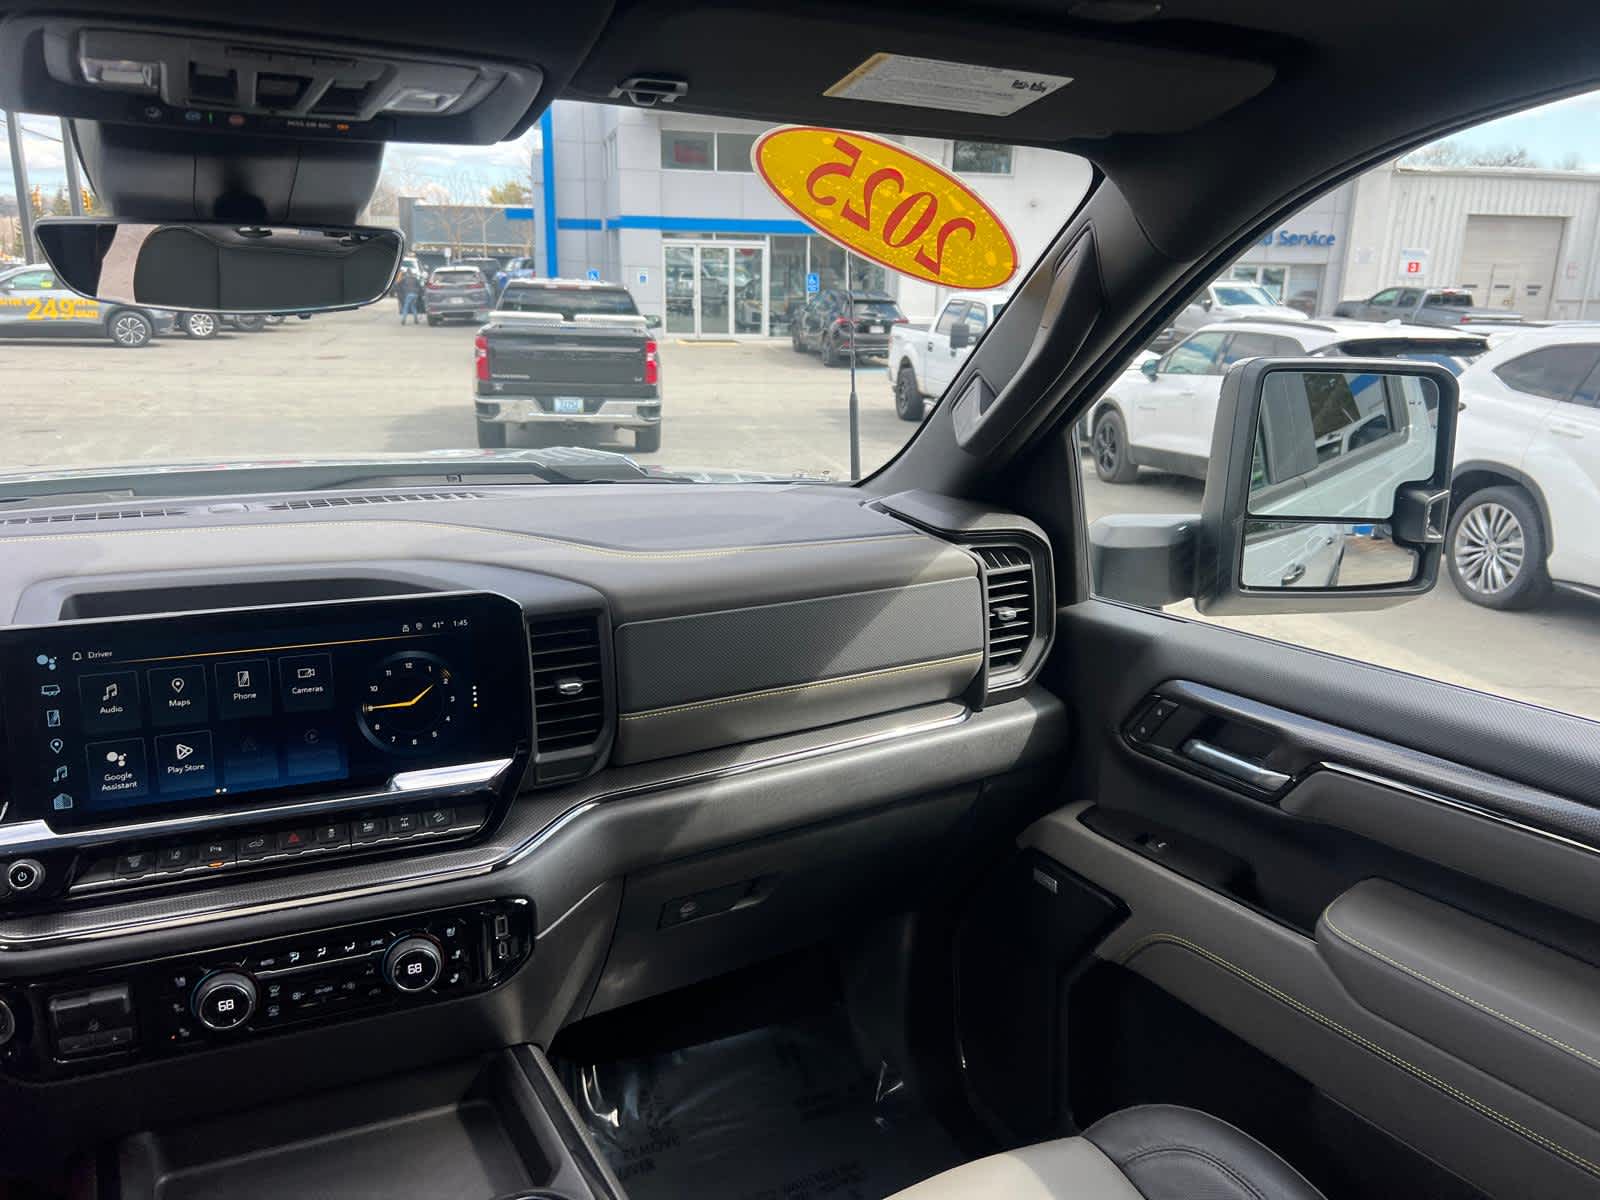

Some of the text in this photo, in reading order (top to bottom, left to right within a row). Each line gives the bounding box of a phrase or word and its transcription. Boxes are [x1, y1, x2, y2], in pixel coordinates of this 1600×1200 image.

[1279, 230, 1336, 246] Service
[26, 297, 75, 320] 249
[453, 619, 468, 627] 1:45
[87, 651, 113, 659] Driver
[291, 686, 324, 695] Cameras
[233, 692, 257, 701] Phone
[168, 699, 191, 708] Maps
[99, 705, 124, 714] Audio
[167, 763, 205, 775] Play Store
[104, 771, 133, 781] Google
[101, 781, 137, 791] Assistant
[407, 962, 423, 975] 68
[217, 999, 234, 1012] 68
